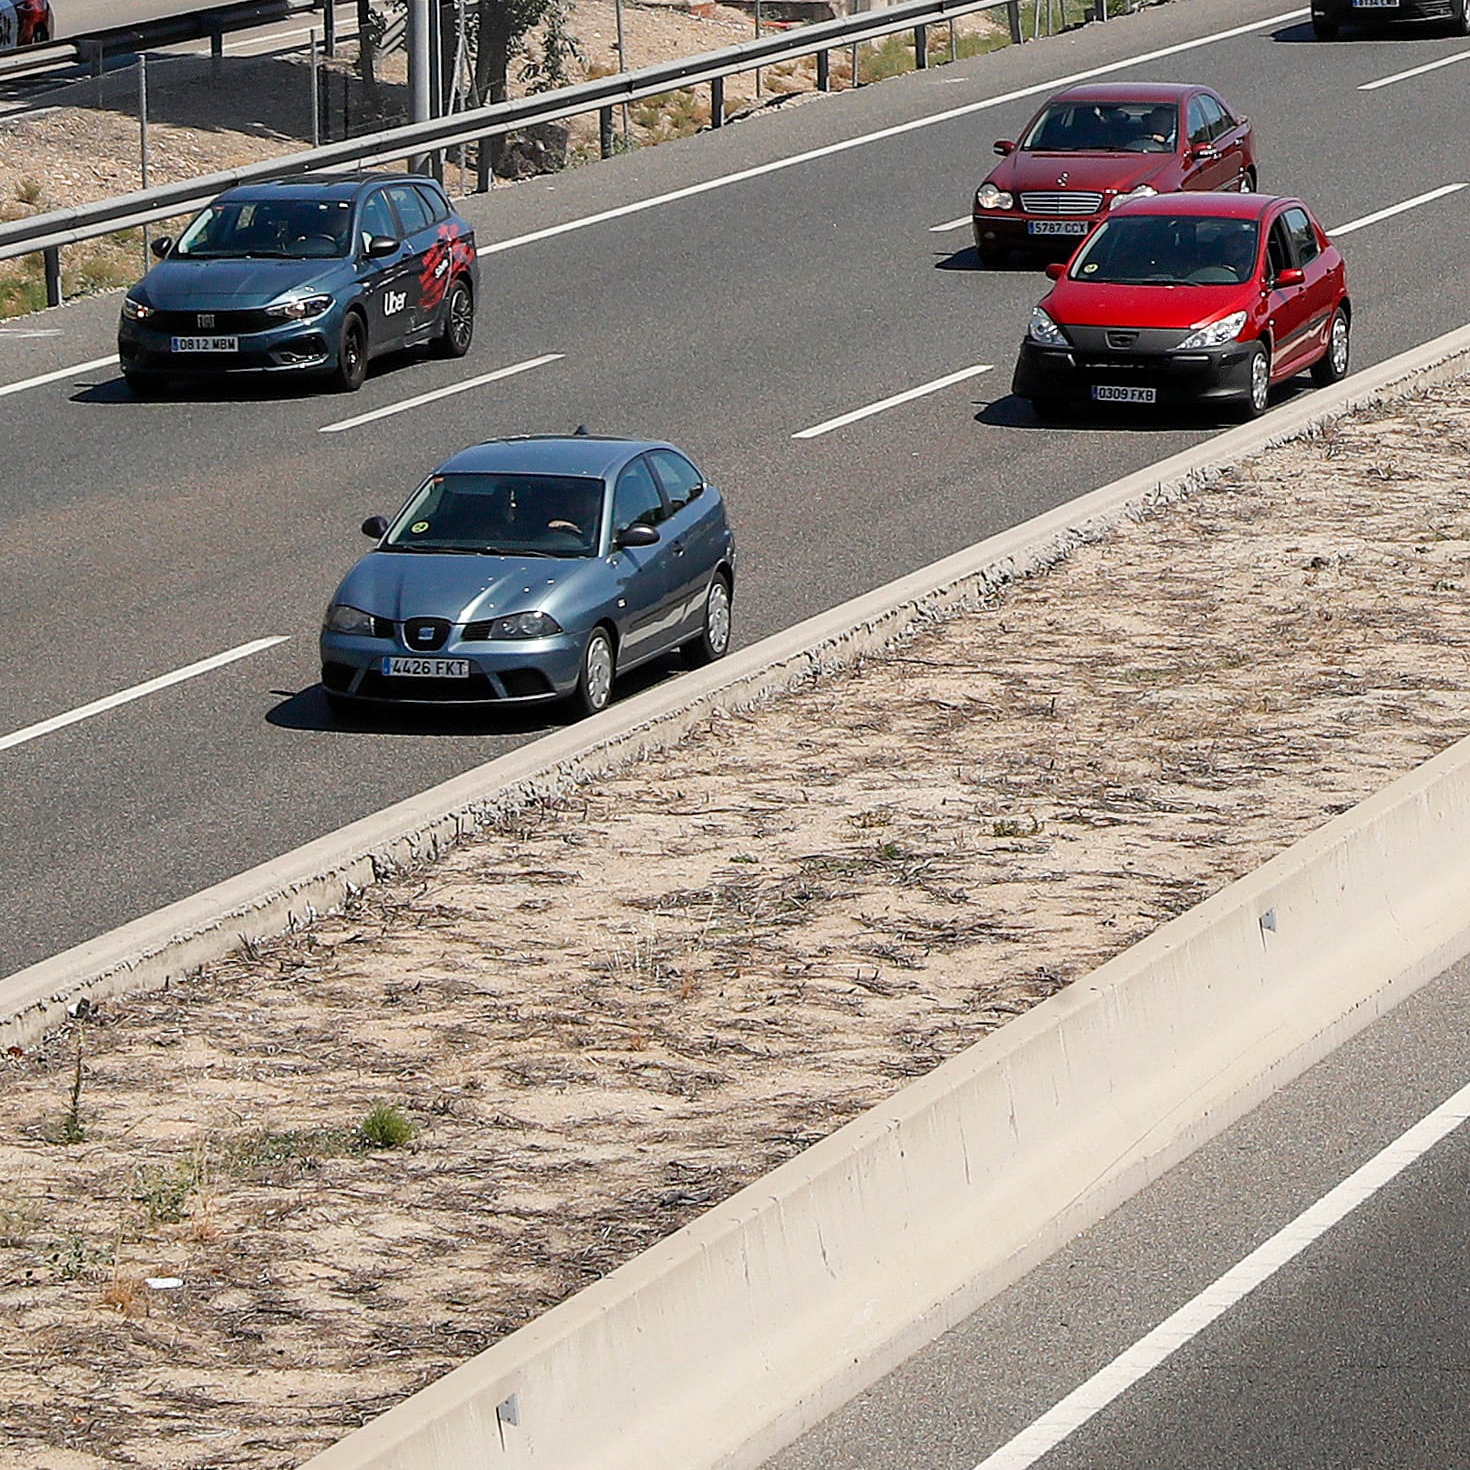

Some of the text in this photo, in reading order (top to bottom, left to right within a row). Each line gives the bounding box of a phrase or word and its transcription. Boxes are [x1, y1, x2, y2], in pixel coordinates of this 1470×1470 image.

[1035, 221, 1063, 234] 5787
[384, 290, 407, 316] Uber
[180, 338, 209, 350] 0812
[1098, 386, 1154, 401] 0309 FKB
[392, 659, 465, 675] 4426 FKT
